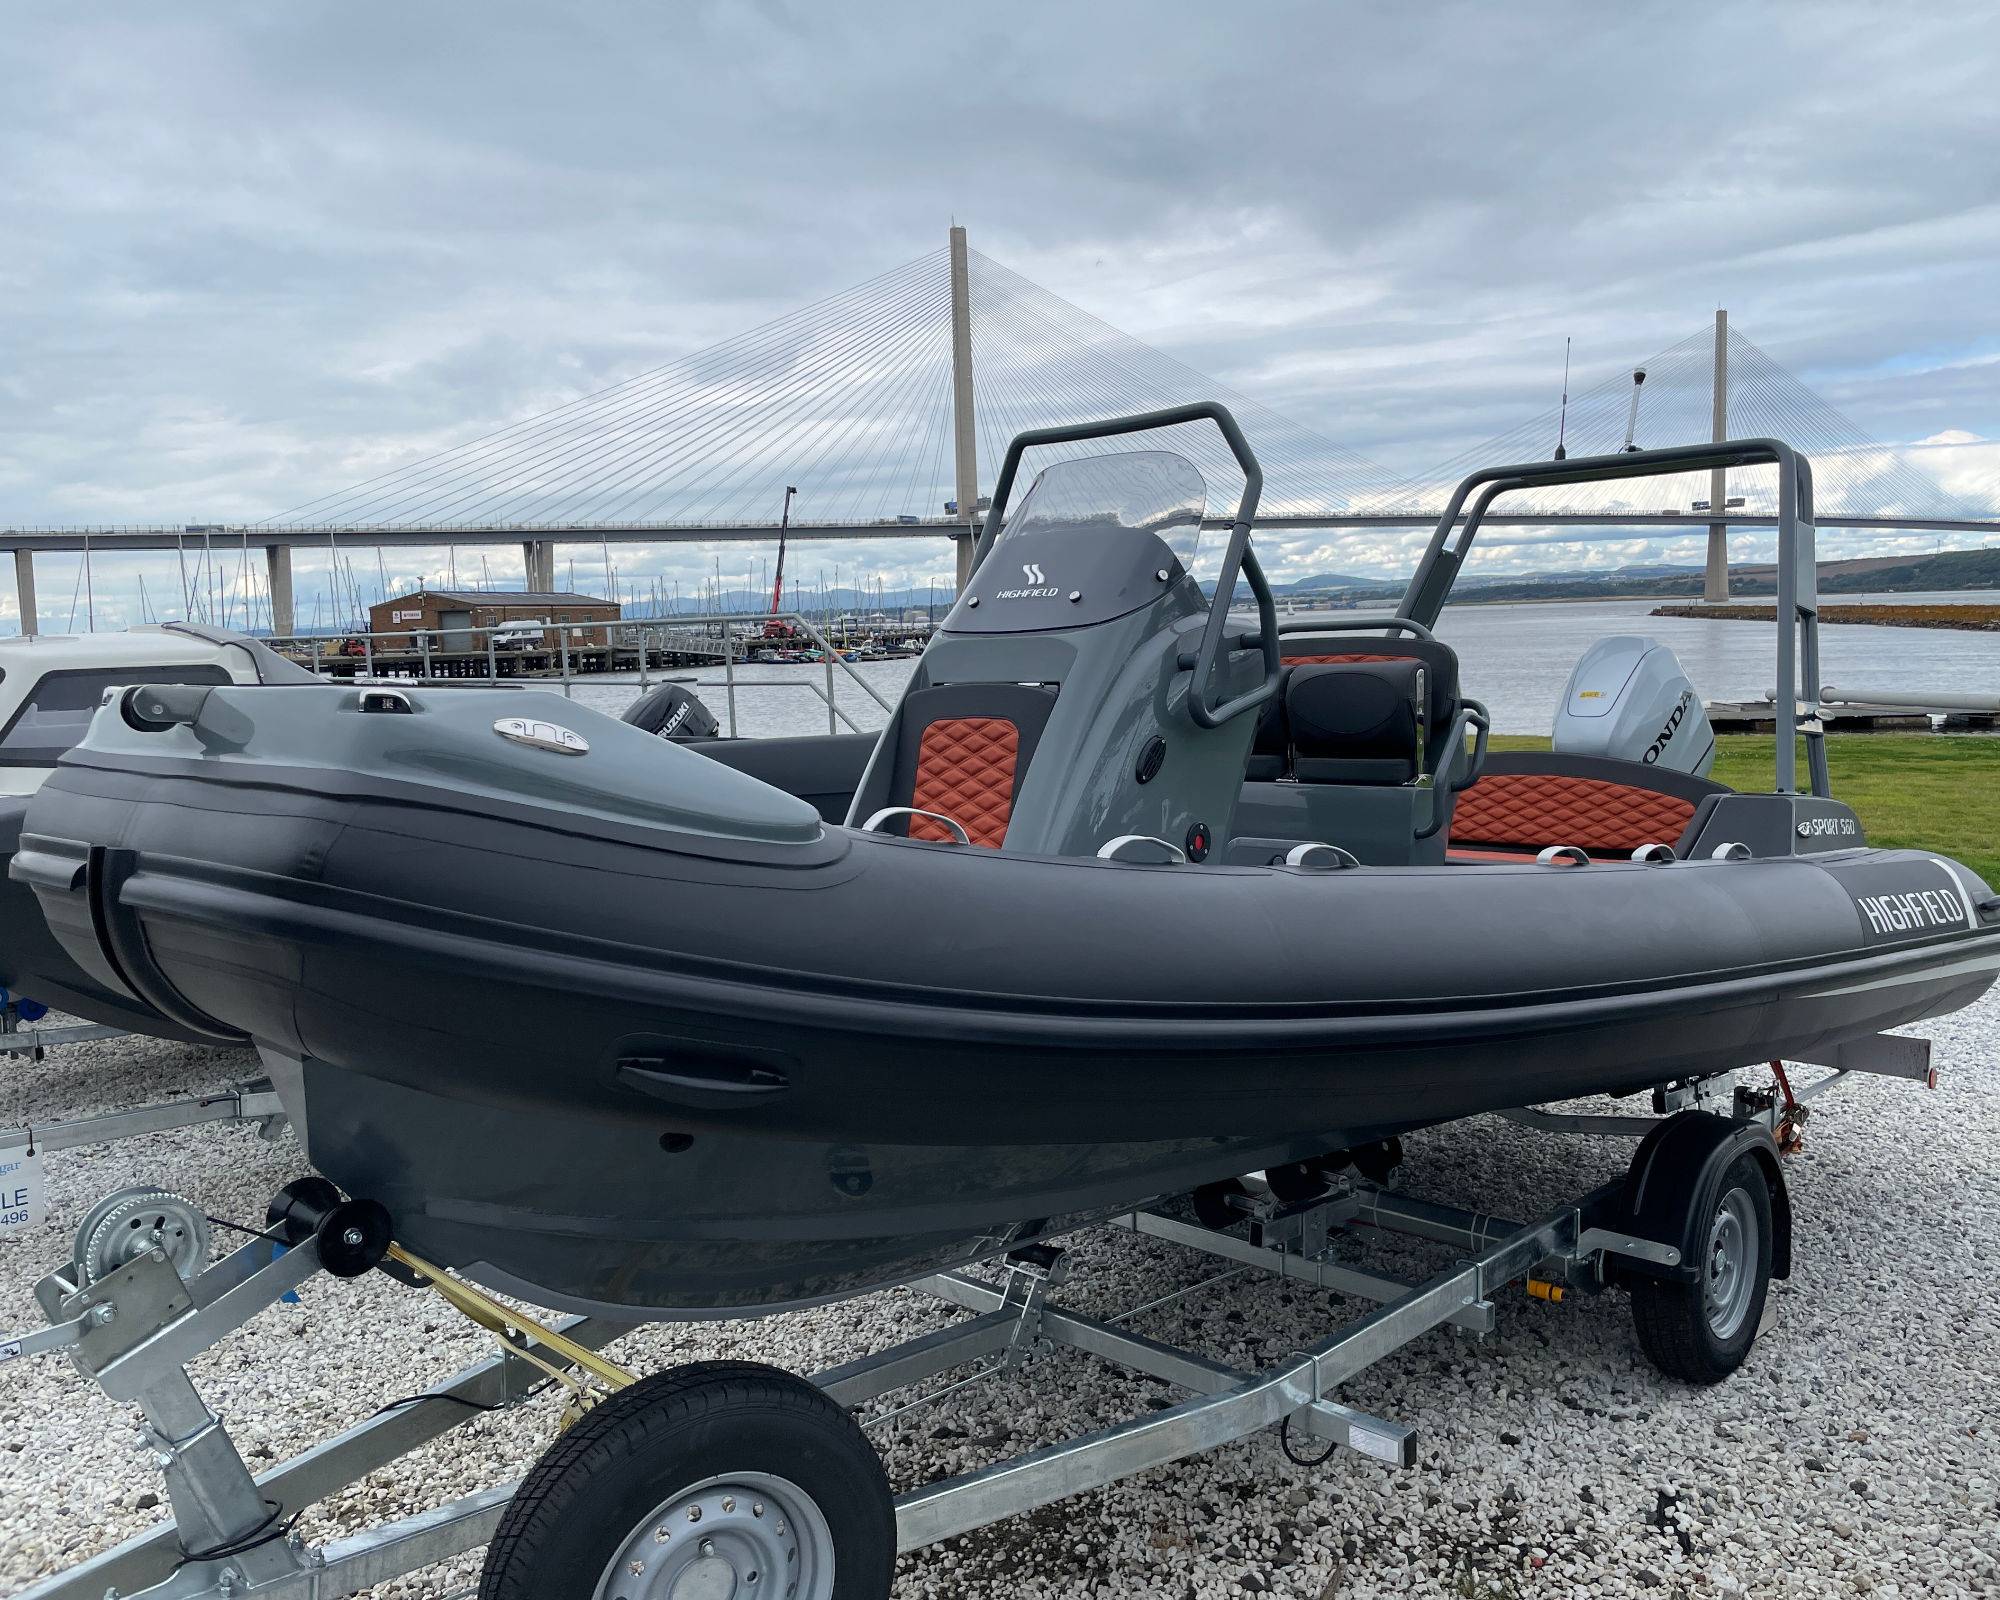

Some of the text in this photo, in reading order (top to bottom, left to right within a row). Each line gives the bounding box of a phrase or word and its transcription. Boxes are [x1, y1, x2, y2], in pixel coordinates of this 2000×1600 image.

[997, 588, 1058, 599] HIGHFIELD
[1642, 690, 1693, 765] ONDA
[1812, 818, 1839, 836] SPORT
[1857, 889, 1964, 934] HIGHFIELD
[0, 1187, 29, 1210] LE
